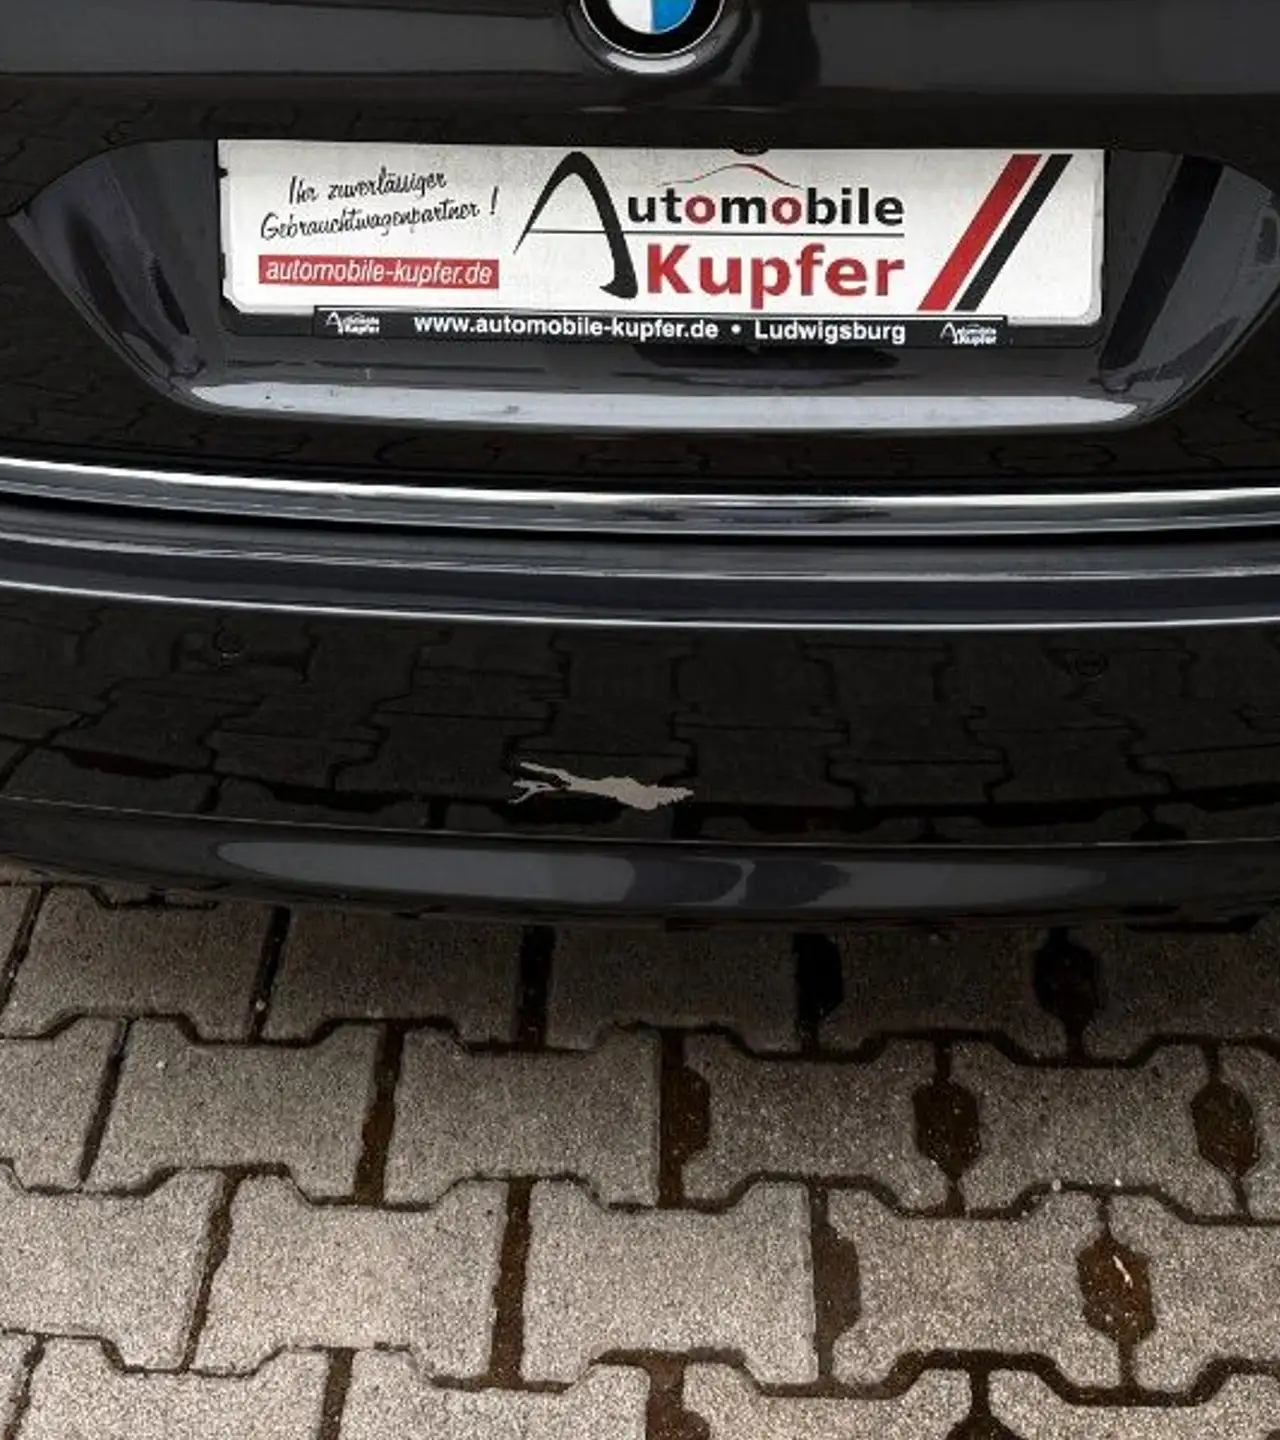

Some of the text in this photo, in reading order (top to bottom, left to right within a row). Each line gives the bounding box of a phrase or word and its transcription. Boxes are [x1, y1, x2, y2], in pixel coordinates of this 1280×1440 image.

[288, 165, 448, 205] Ihr zuverlässiger
[260, 198, 481, 240] Gebrauchtwagenpartner
[513, 151, 905, 299] Automobile
[266, 259, 493, 287] automobile-kupfer.de
[646, 243, 906, 310] Kupfer
[413, 316, 906, 345] www.automobile-kupfer.de Ludwigsburg
